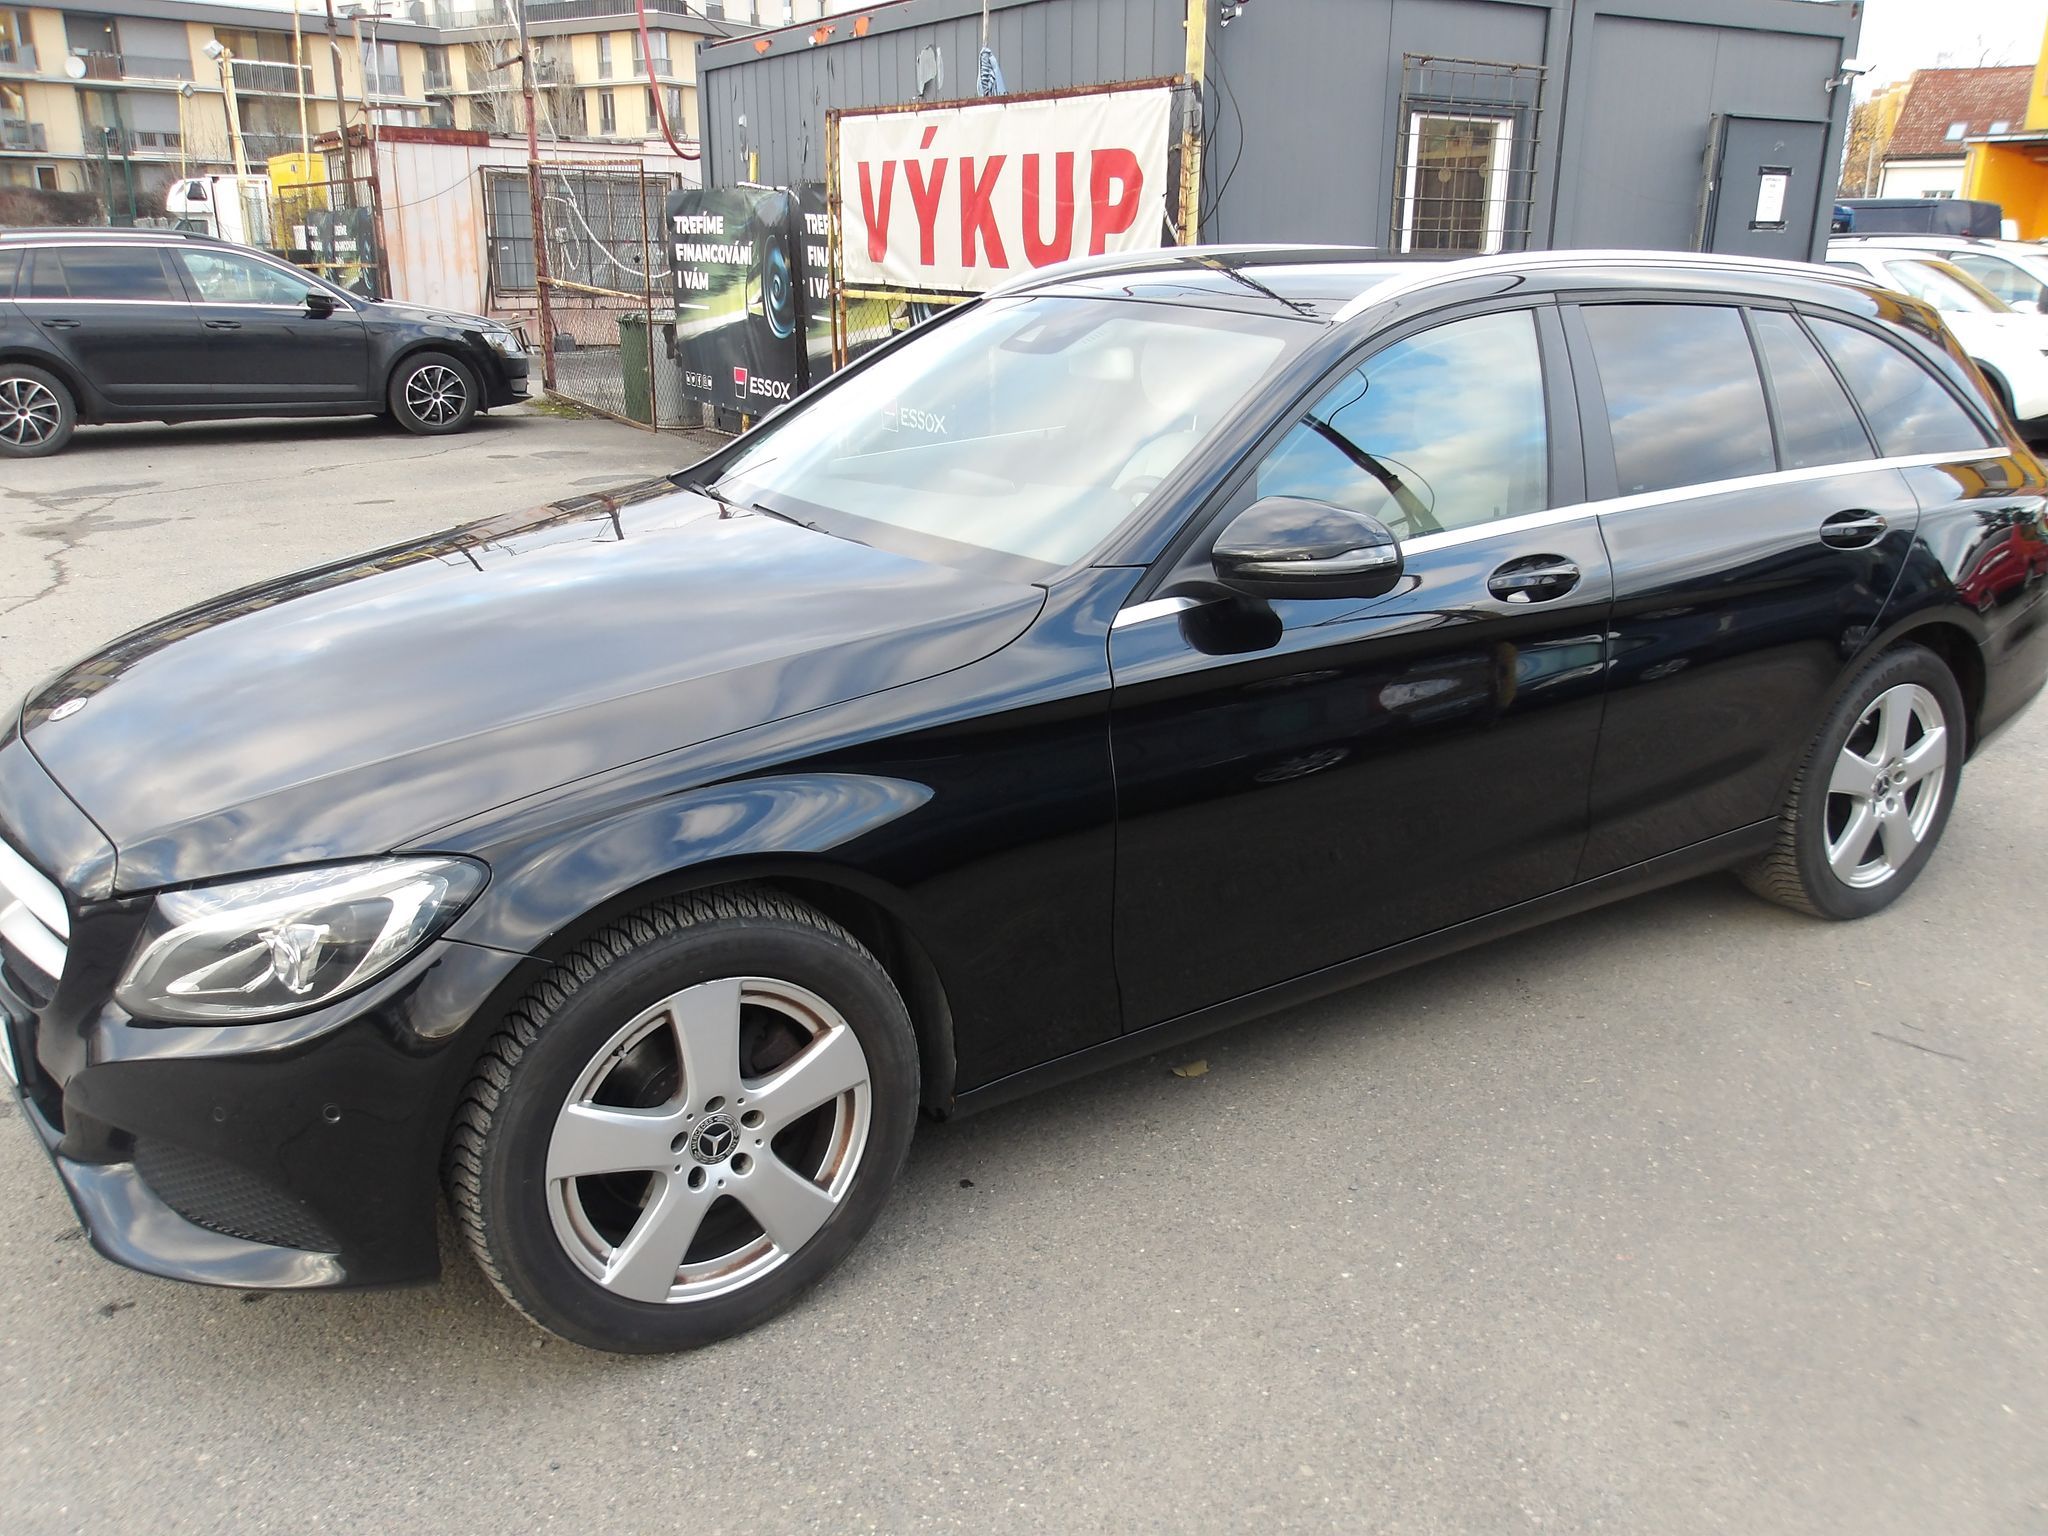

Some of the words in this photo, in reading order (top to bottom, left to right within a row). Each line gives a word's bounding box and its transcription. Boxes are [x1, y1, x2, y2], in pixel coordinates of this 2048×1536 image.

[858, 125, 1143, 269] VÝKUP
[673, 210, 724, 235] TREFÍME
[675, 240, 753, 266] FINANCOVÁNÍ
[677, 270, 683, 289] I
[683, 266, 709, 291] VÁM
[809, 276, 815, 298] I
[750, 376, 791, 400] ESSOX
[900, 407, 948, 434] ESSOX
